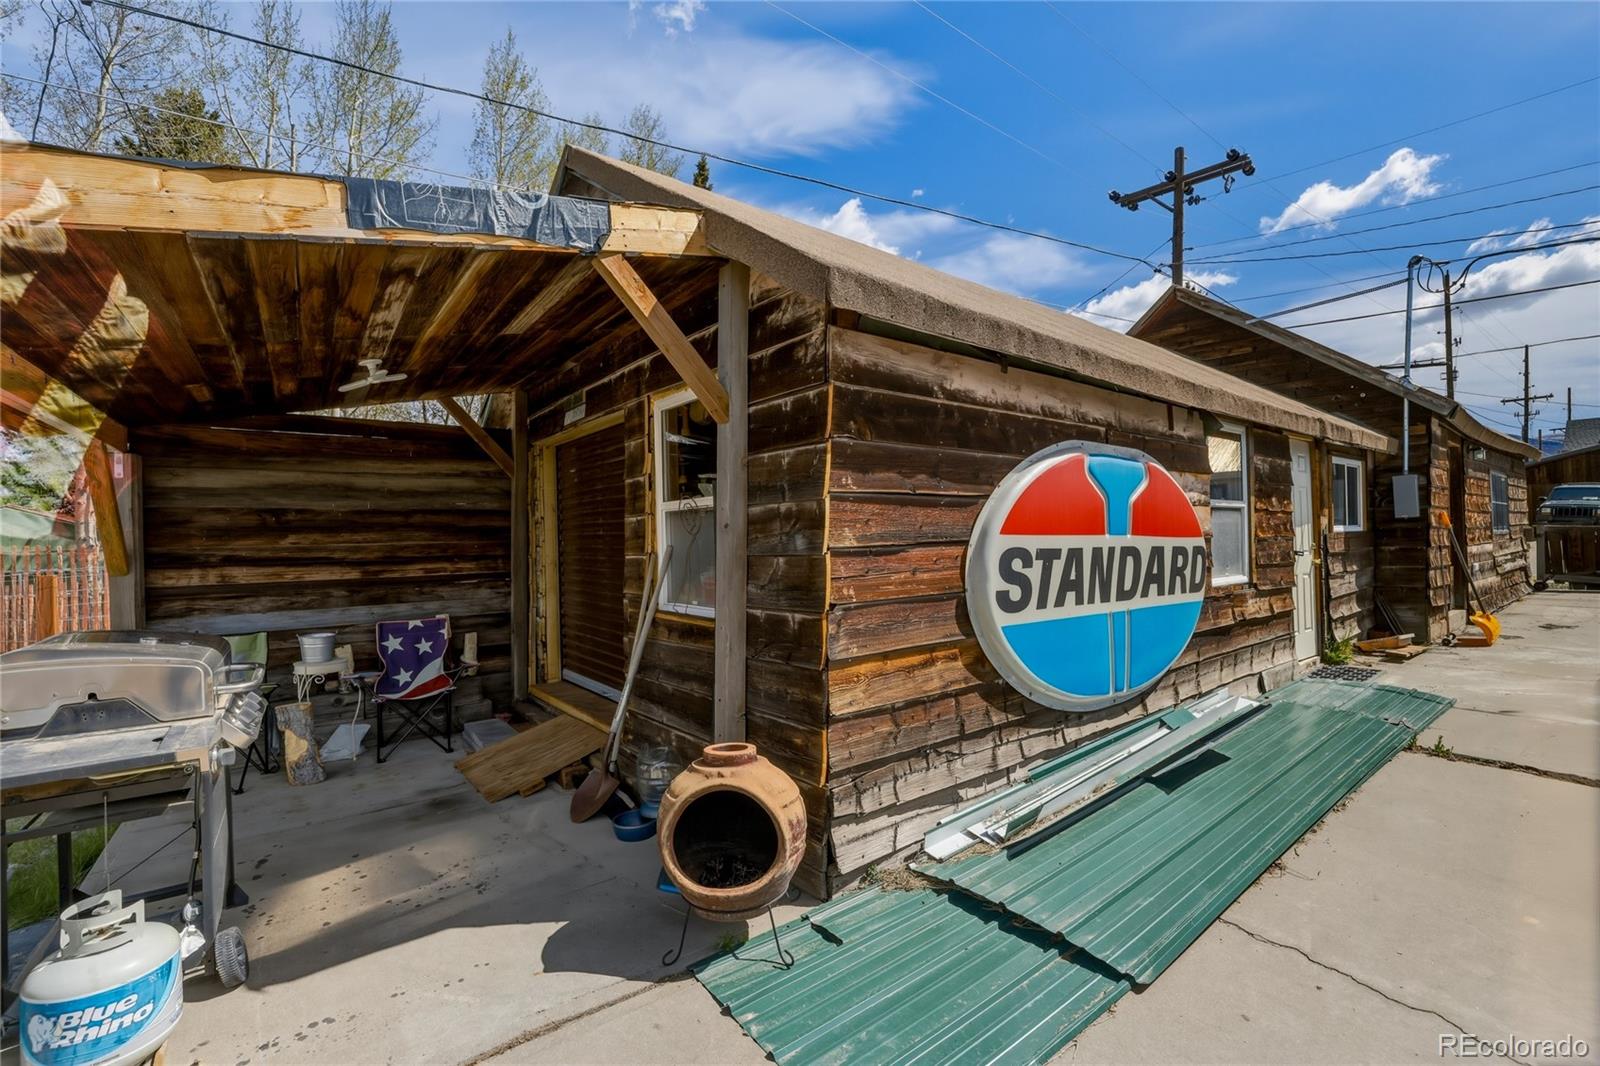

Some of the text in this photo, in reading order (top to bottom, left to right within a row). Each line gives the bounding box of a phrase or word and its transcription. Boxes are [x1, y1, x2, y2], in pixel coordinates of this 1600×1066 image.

[995, 545, 1207, 614] STANDARD
[49, 1002, 154, 1049] Rhino
[59, 993, 138, 1029] Blue
